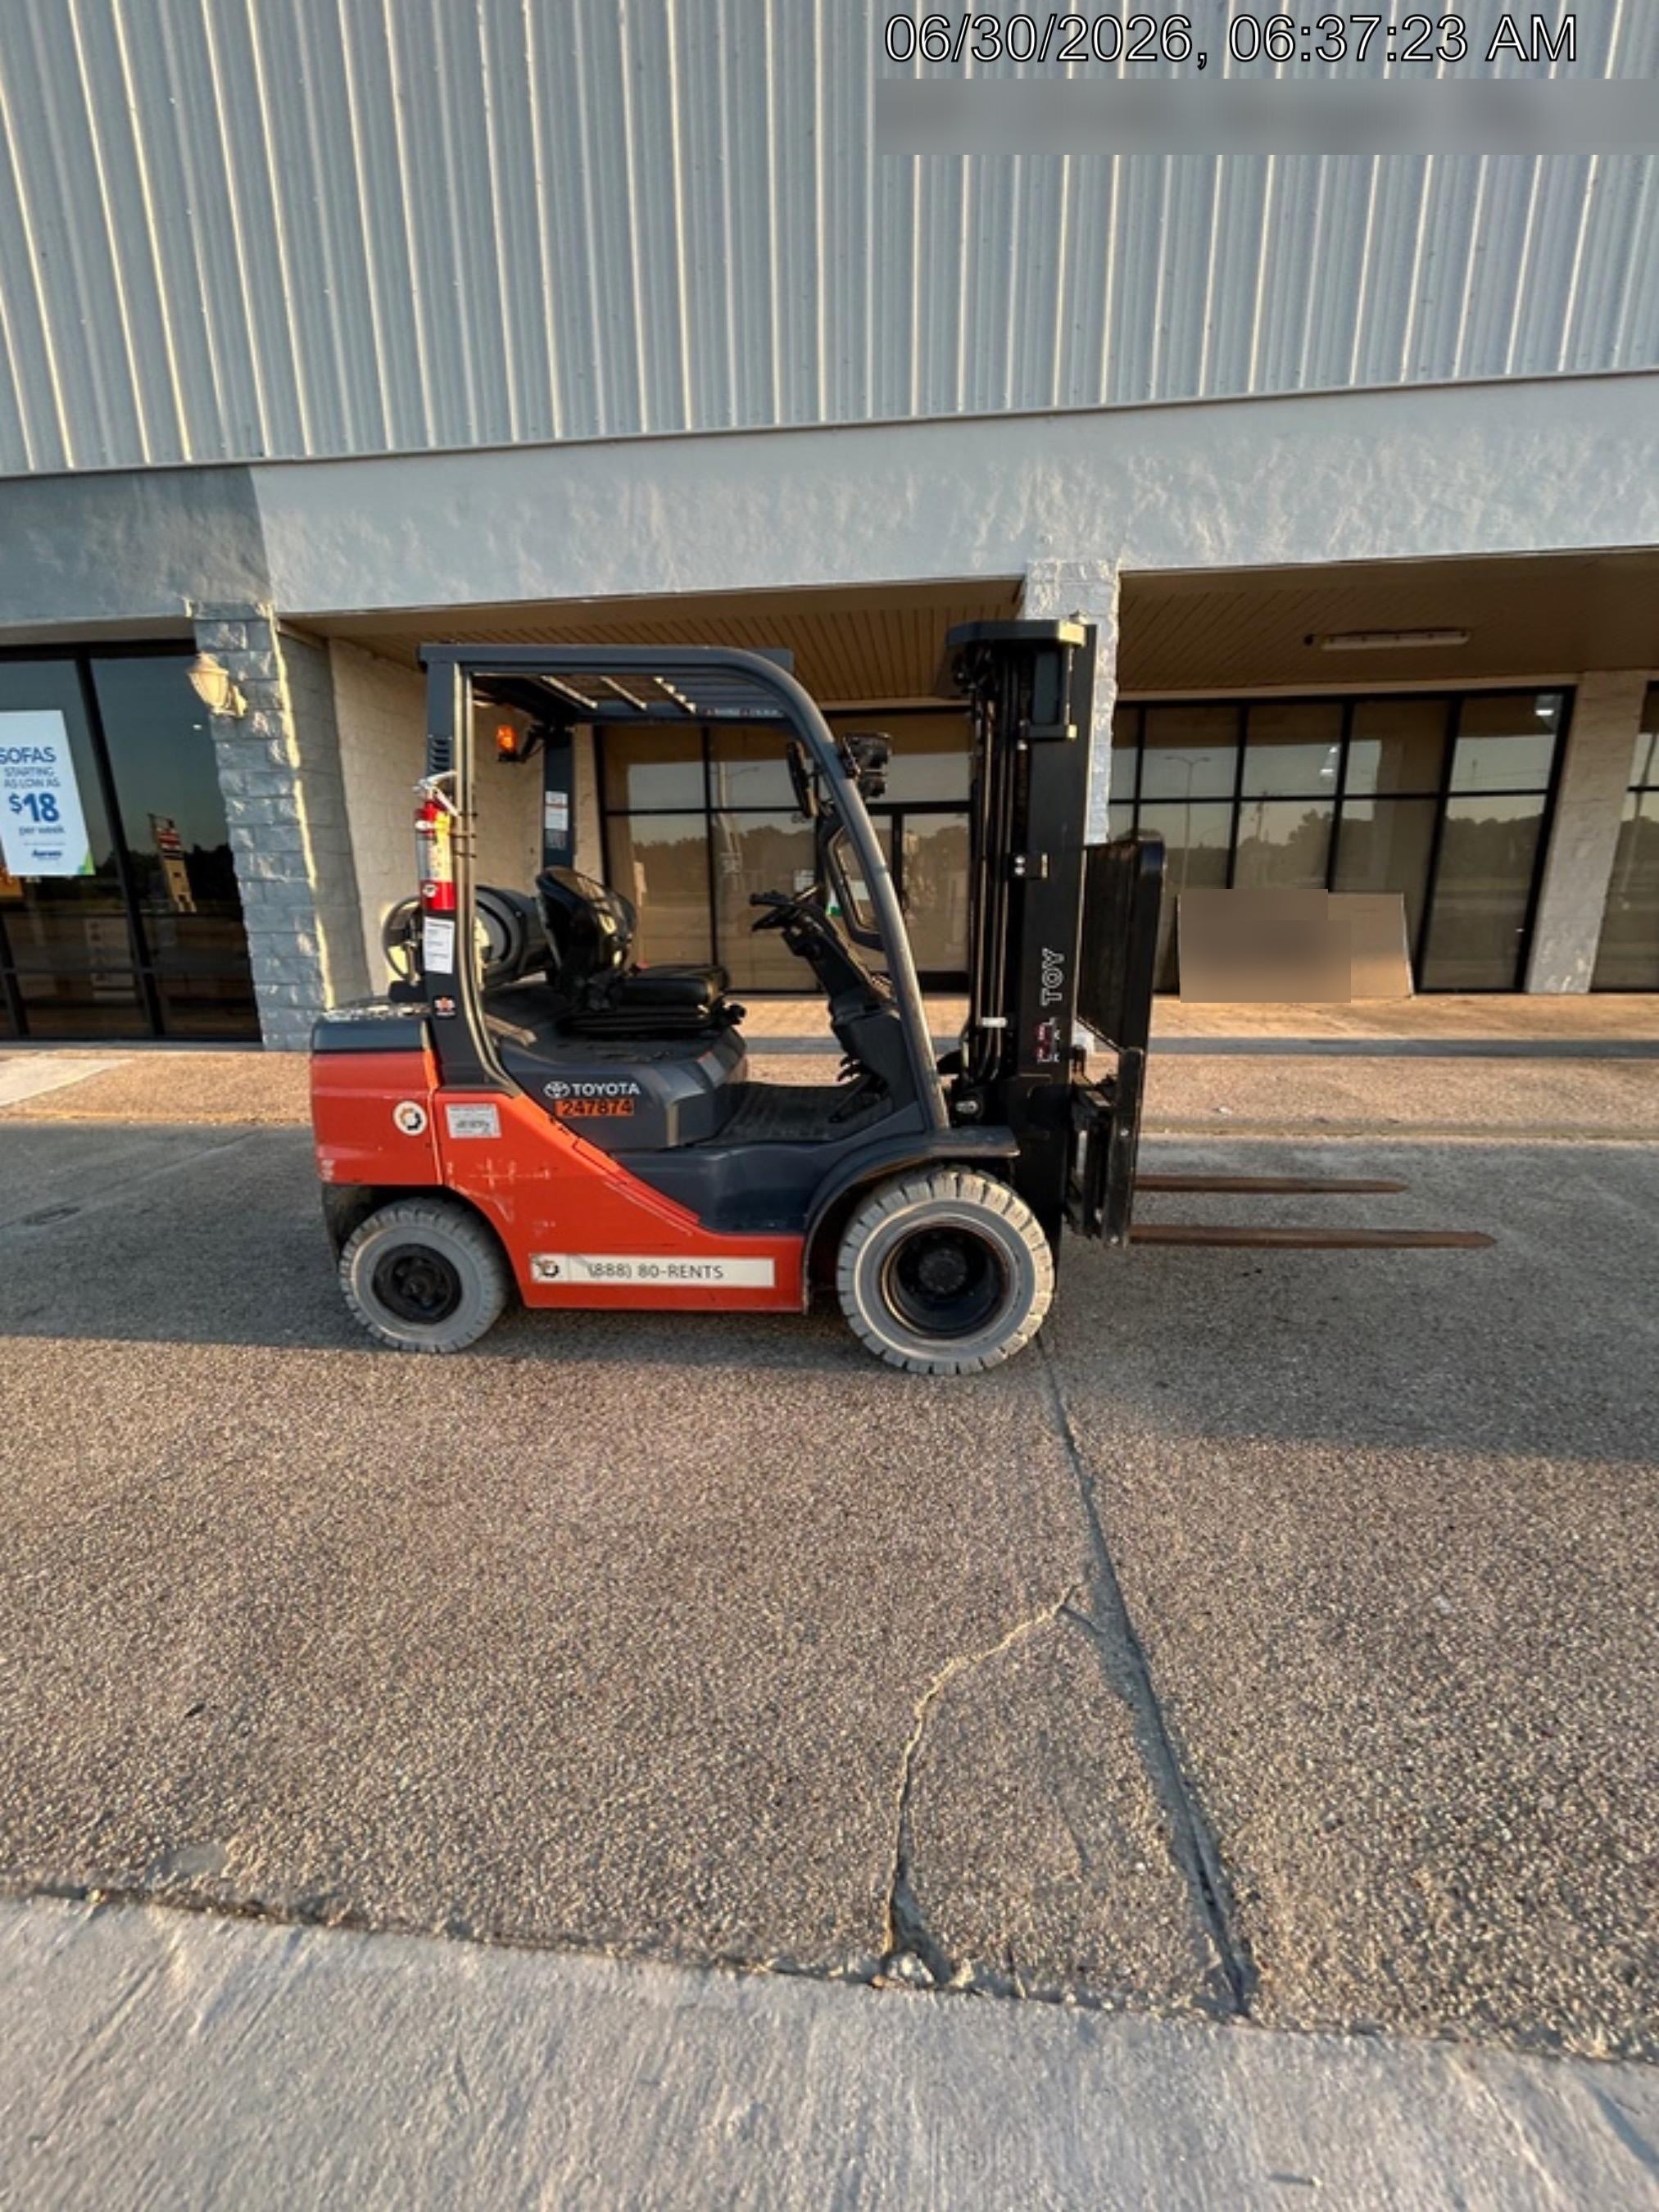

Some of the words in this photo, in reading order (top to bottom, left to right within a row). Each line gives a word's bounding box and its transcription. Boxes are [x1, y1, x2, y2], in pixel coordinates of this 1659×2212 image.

[9, 792, 60, 822] $18
[1041, 947, 1065, 1008] TOY
[572, 1082, 641, 1096] TOYOTA
[561, 1099, 632, 1115] 247874
[637, 1263, 723, 1279] 80-RENTS
